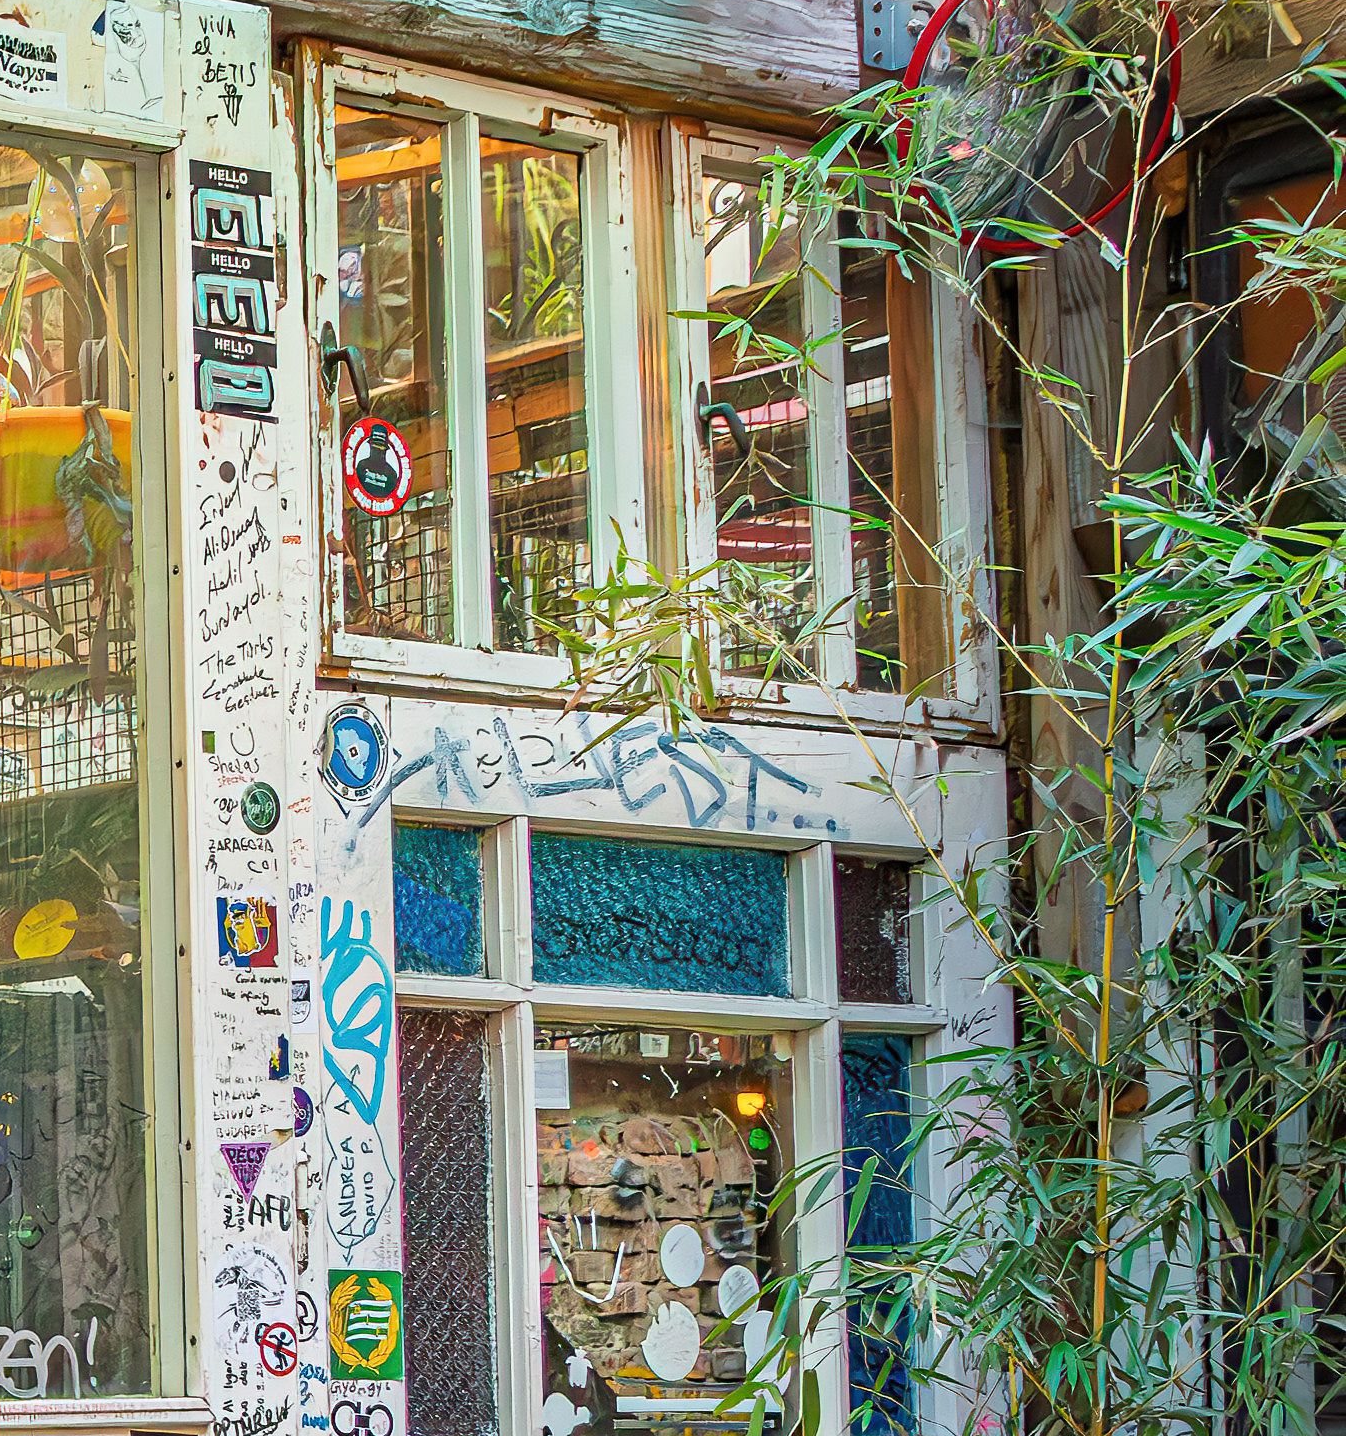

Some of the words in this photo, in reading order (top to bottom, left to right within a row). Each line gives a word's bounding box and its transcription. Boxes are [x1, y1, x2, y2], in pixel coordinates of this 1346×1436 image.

[208, 168, 248, 185] HELLO
[210, 253, 250, 271] HELLO
[214, 337, 253, 356] HELLO
